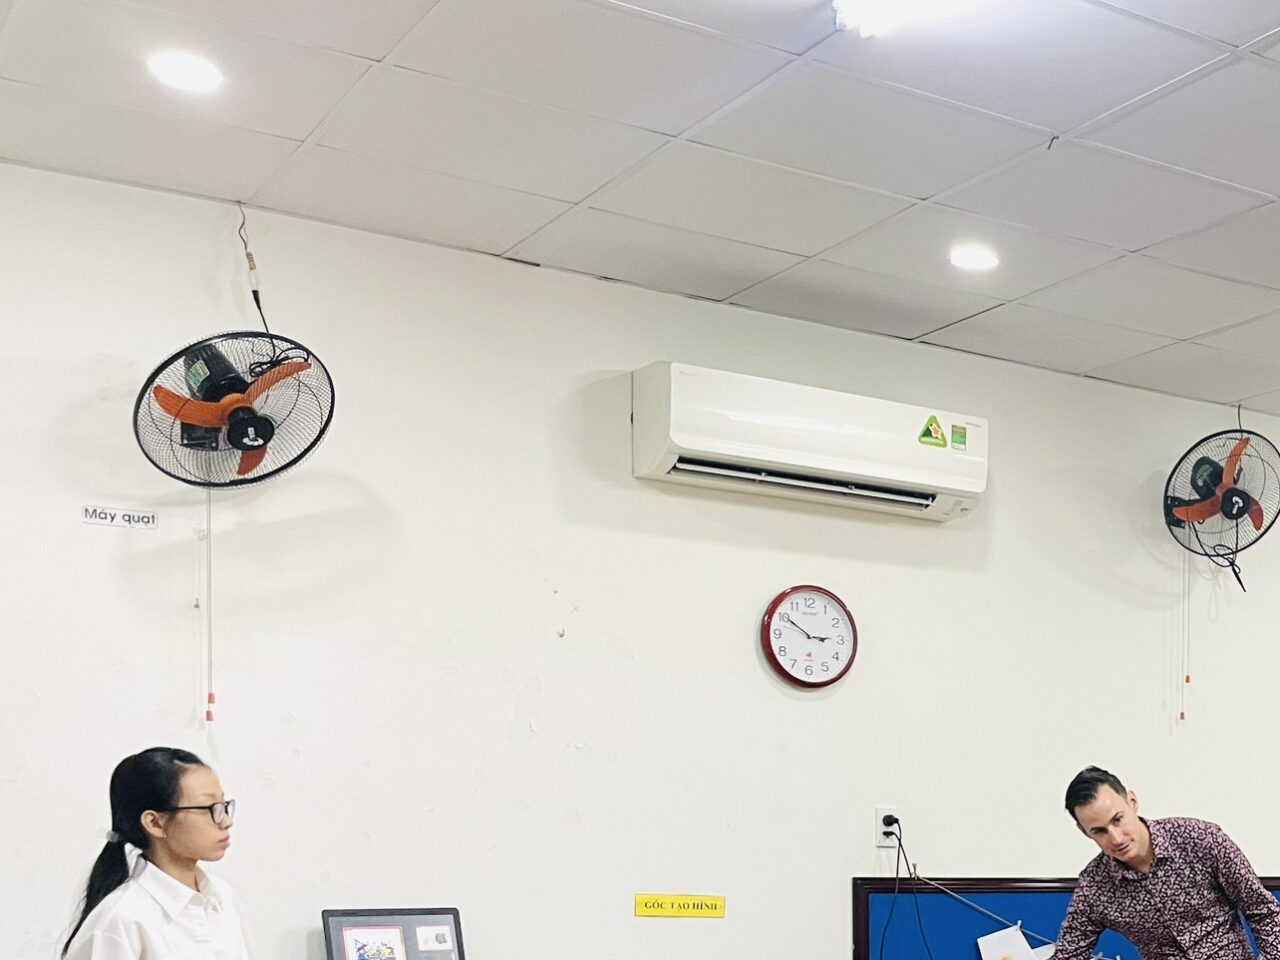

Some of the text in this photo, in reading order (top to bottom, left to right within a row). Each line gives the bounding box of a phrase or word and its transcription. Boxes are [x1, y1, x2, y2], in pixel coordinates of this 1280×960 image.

[84, 507, 117, 523] Máy
[790, 601, 799, 612] 11
[804, 597, 816, 609] 12
[778, 611, 790, 623] 10
[831, 617, 840, 629] 2
[773, 628, 782, 639] 9
[836, 634, 845, 646] 3
[778, 645, 787, 657] 8
[831, 651, 839, 661] 4
[789, 658, 797, 669] 7
[820, 661, 829, 672] 5
[804, 665, 813, 676] 6
[644, 899, 667, 910] GÓC
